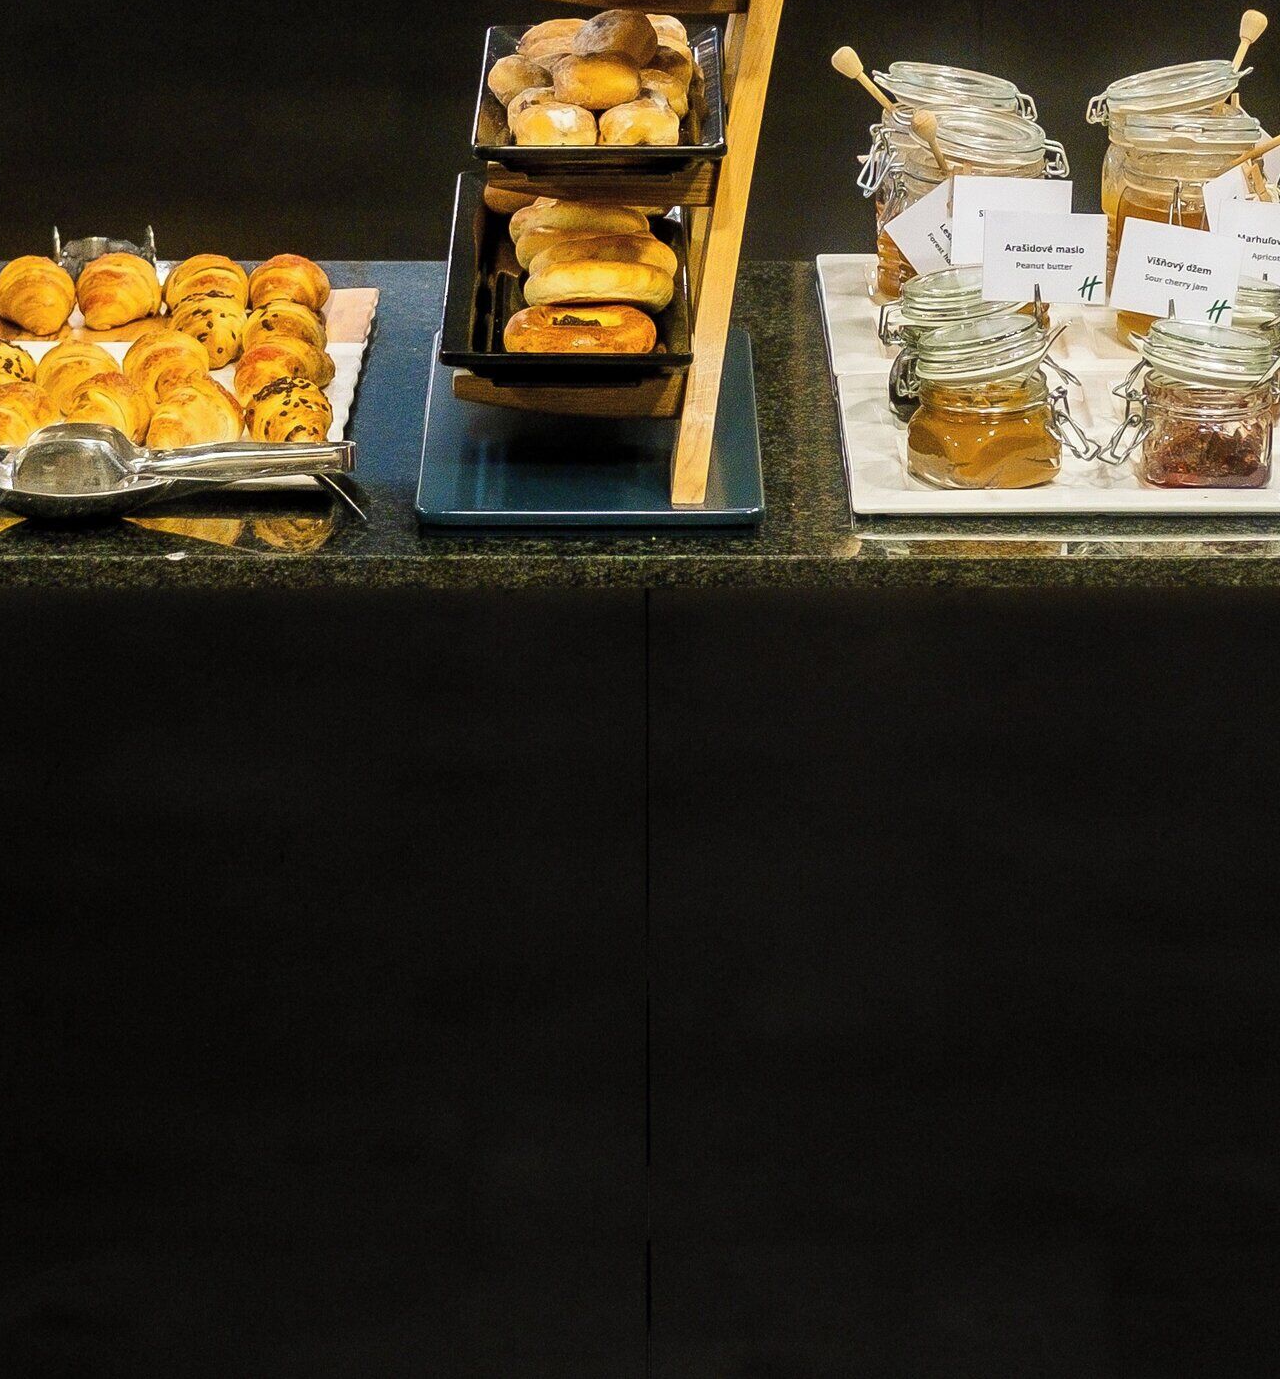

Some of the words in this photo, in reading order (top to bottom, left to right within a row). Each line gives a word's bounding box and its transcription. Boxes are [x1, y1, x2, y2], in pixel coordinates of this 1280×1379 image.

[927, 232, 945, 255] Forest
[1004, 243, 1053, 254] Arašidové
[1055, 245, 1085, 254] maslo
[1251, 252, 1280, 263] Apricot
[1015, 261, 1045, 270] Peanut
[1046, 261, 1073, 271] butter
[1147, 255, 1184, 272] Višňový
[1186, 263, 1212, 276] džem
[1144, 273, 1163, 284] Sour
[1164, 277, 1192, 292] cherry
[1191, 282, 1209, 292] jam
